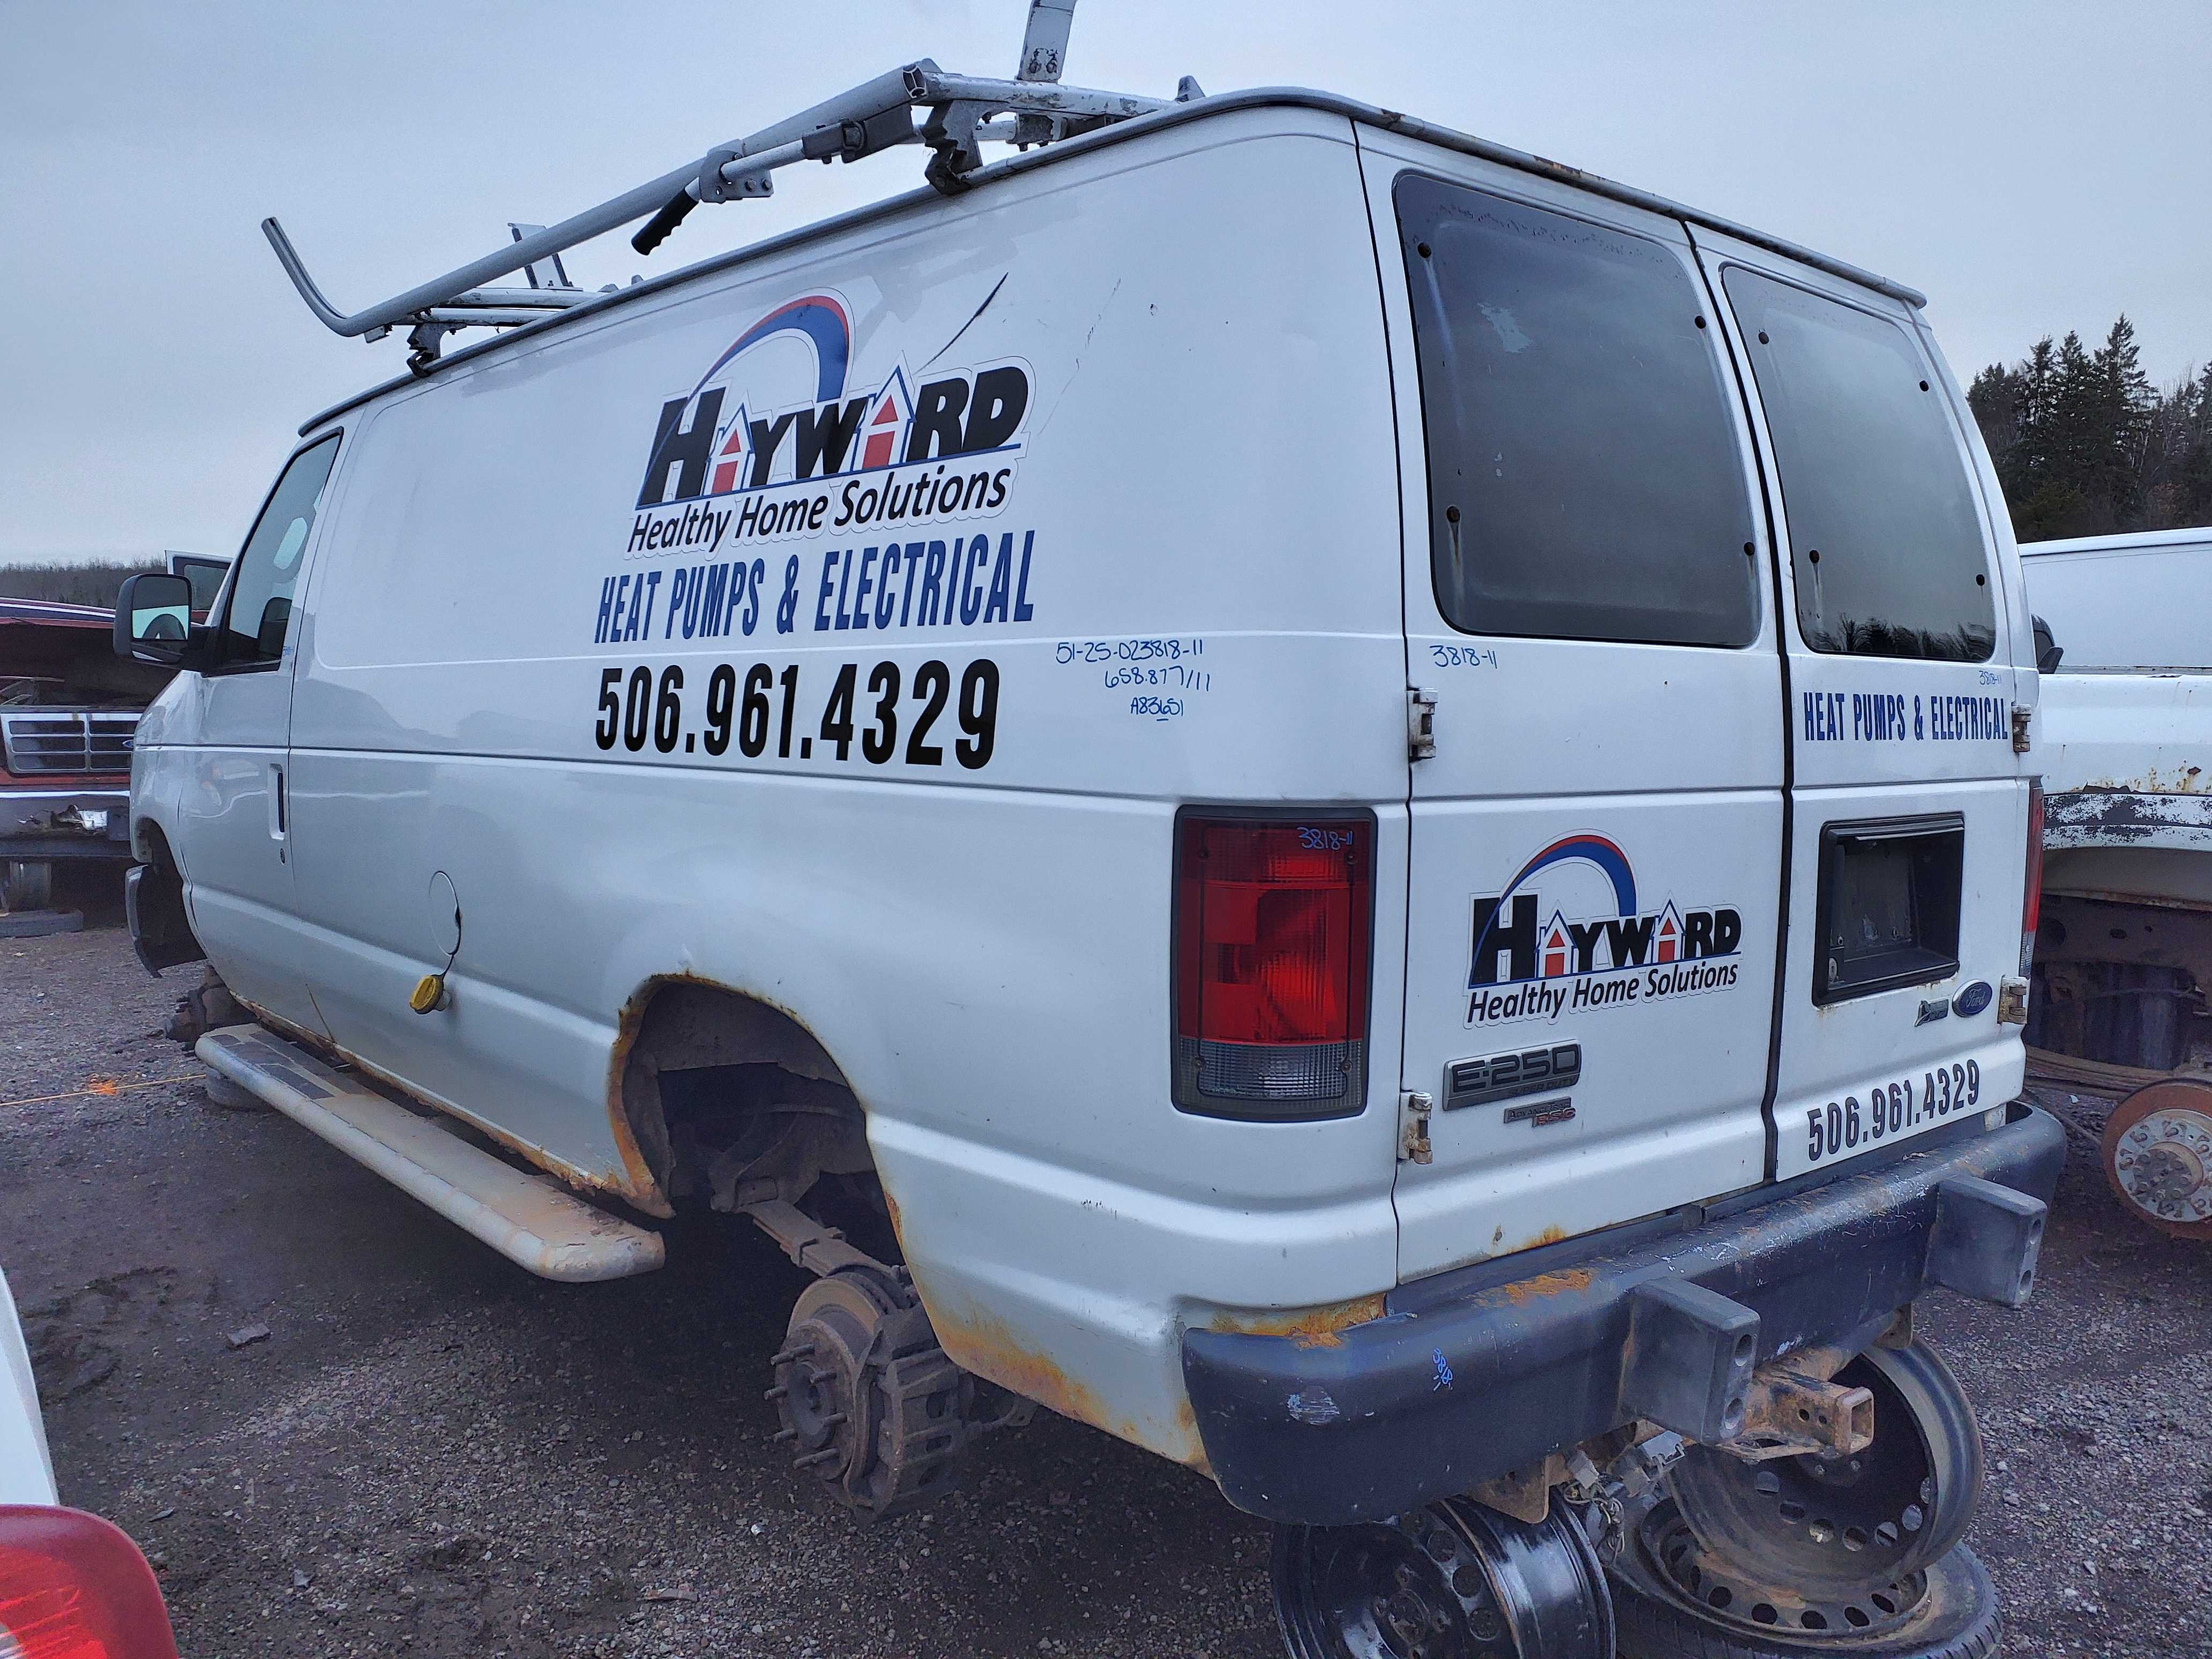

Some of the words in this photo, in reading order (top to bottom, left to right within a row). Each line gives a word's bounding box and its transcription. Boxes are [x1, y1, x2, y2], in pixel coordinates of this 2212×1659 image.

[637, 364, 1028, 508] HAYWARD
[627, 497, 732, 552] Healthy
[735, 493, 828, 541] Home
[834, 464, 1011, 526] Solutions
[594, 570, 662, 643] HEAT
[666, 558, 765, 640] PUMPS
[776, 554, 799, 634] &
[814, 530, 1035, 631] ELECTRICAL
[1429, 645, 1498, 669] 3818-11
[595, 659, 1000, 770] 506.961.4329
[1804, 692, 1845, 741] HEAT
[1853, 693, 1905, 742] PUMPS
[1914, 695, 1924, 740] &
[1931, 696, 2008, 740] ELECTRICAL
[1297, 826, 1353, 850] 3818-11
[1470, 893, 1742, 986] HAYWARD
[1467, 981, 1566, 1023] Healthy
[1572, 977, 1639, 1009] Home
[1645, 961, 1738, 998] Solutions
[1966, 988, 1986, 1007] Ford
[1452, 1043, 1579, 1093] E-250
[1508, 1083, 1544, 1097] SUPER
[1807, 1058, 1980, 1162] 506.961.4329
